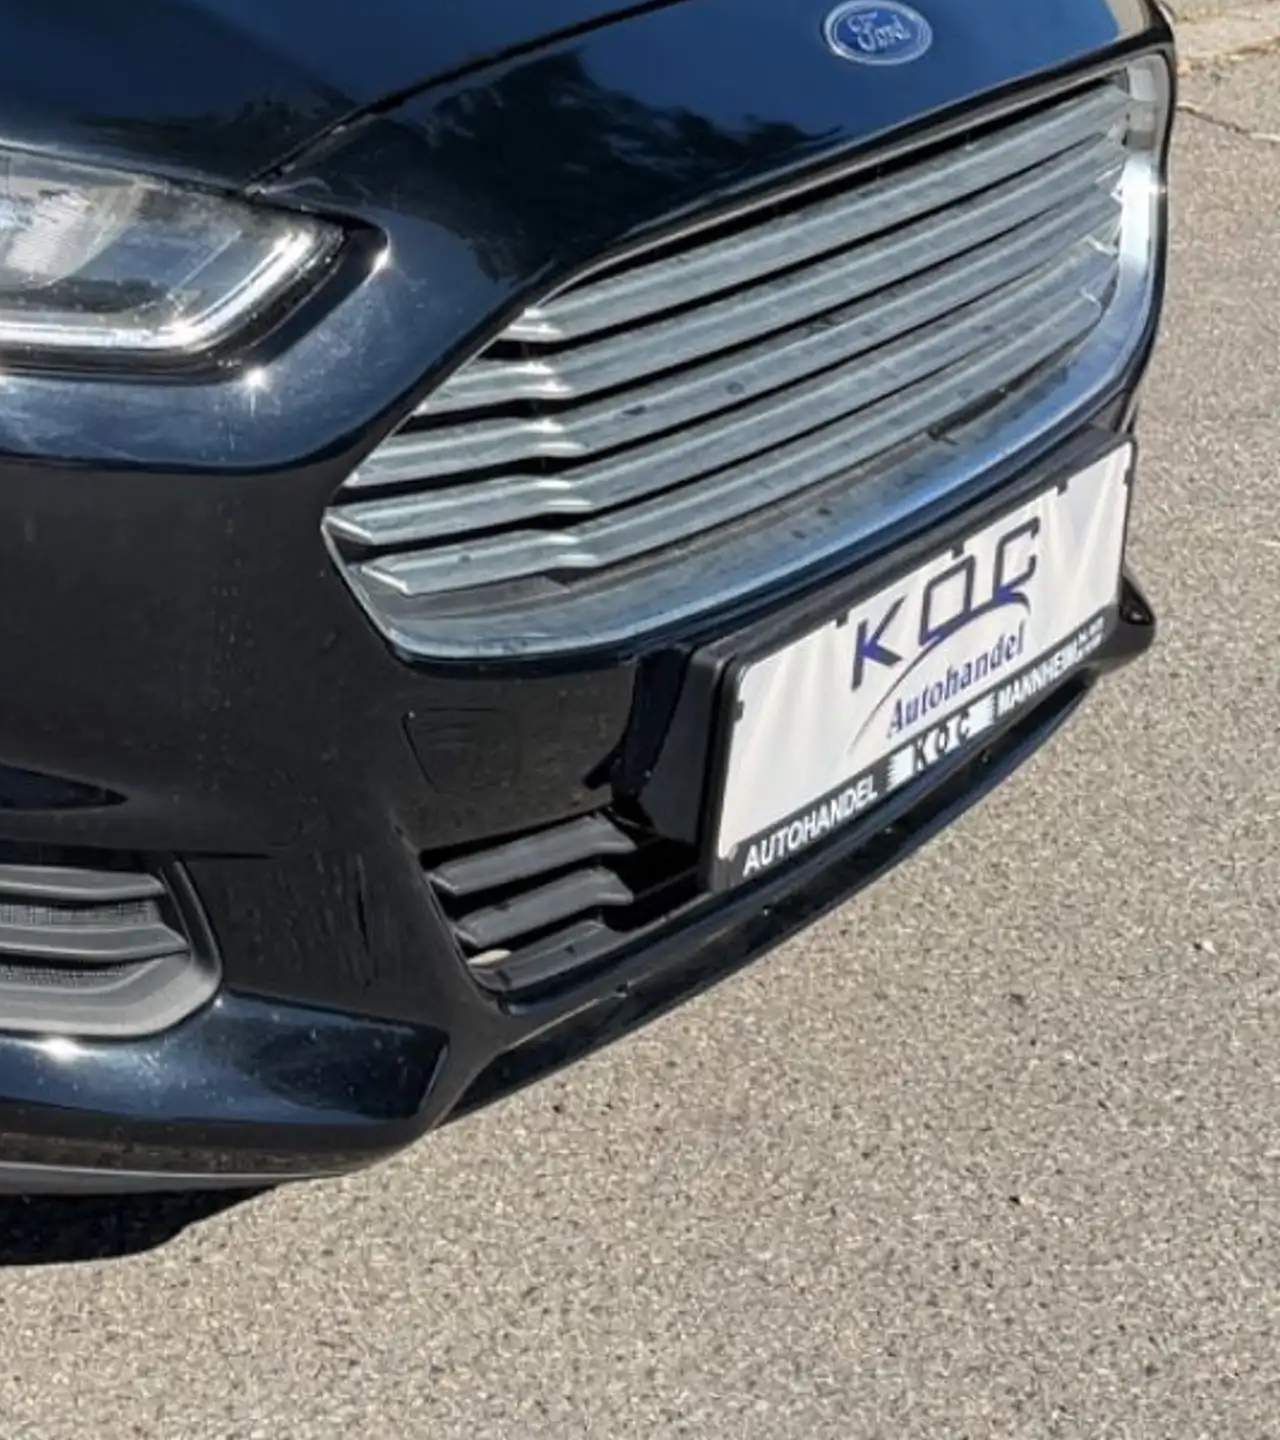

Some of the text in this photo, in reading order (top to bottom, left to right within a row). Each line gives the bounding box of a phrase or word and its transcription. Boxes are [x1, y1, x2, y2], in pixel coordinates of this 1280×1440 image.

[845, 10, 912, 53] Ford
[888, 619, 1026, 738] Autohandel
[742, 774, 879, 878] AUTOHANDEL
